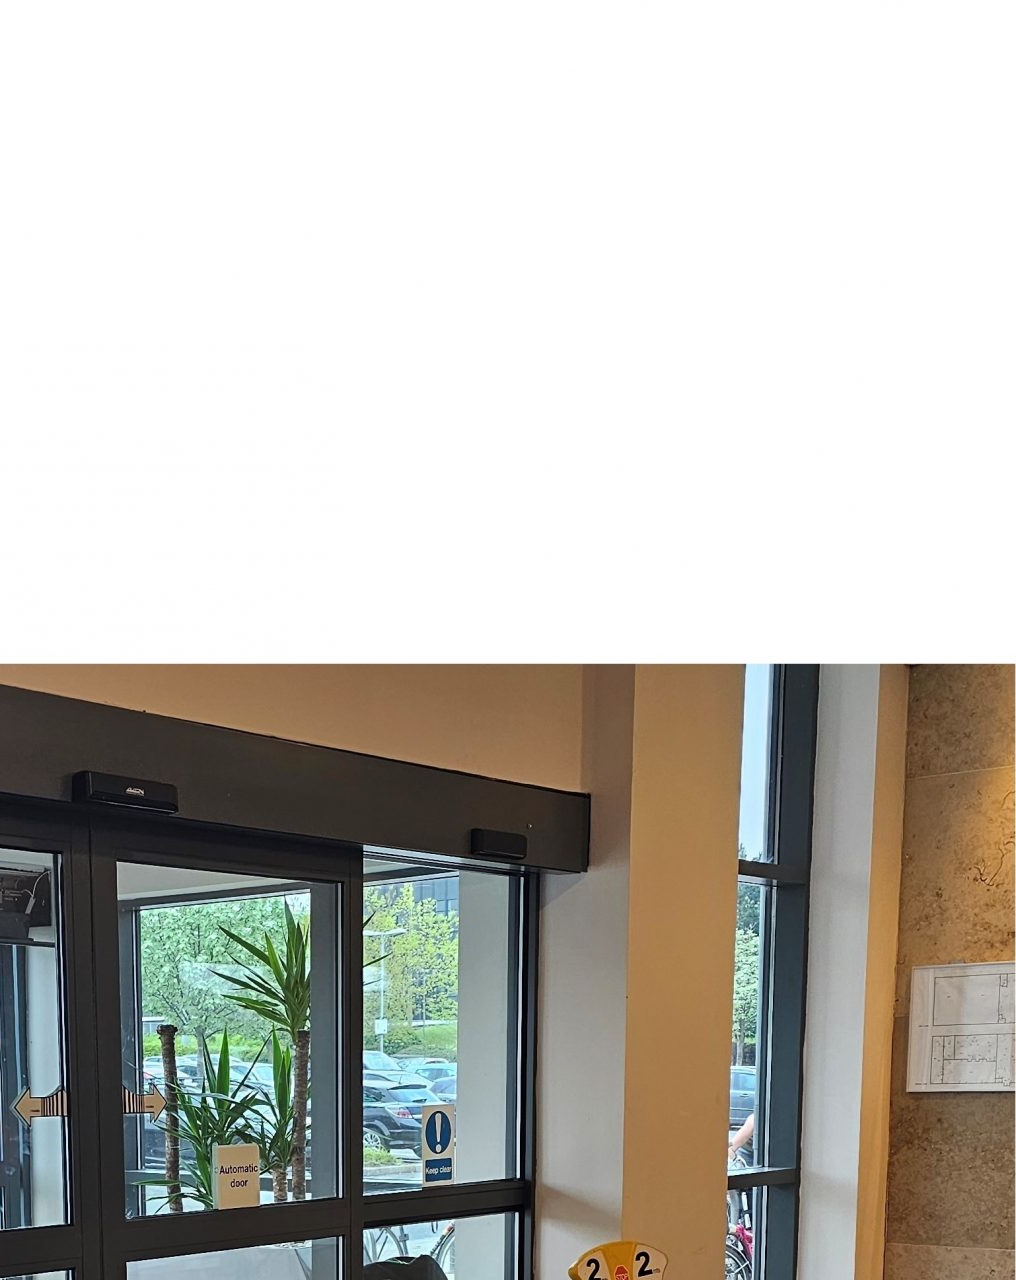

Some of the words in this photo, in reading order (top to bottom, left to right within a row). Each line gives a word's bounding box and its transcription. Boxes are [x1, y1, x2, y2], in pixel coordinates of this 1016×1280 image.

[219, 1163, 258, 1175] Automatic
[230, 1178, 248, 1188] door
[635, 1251, 653, 1277] 2
